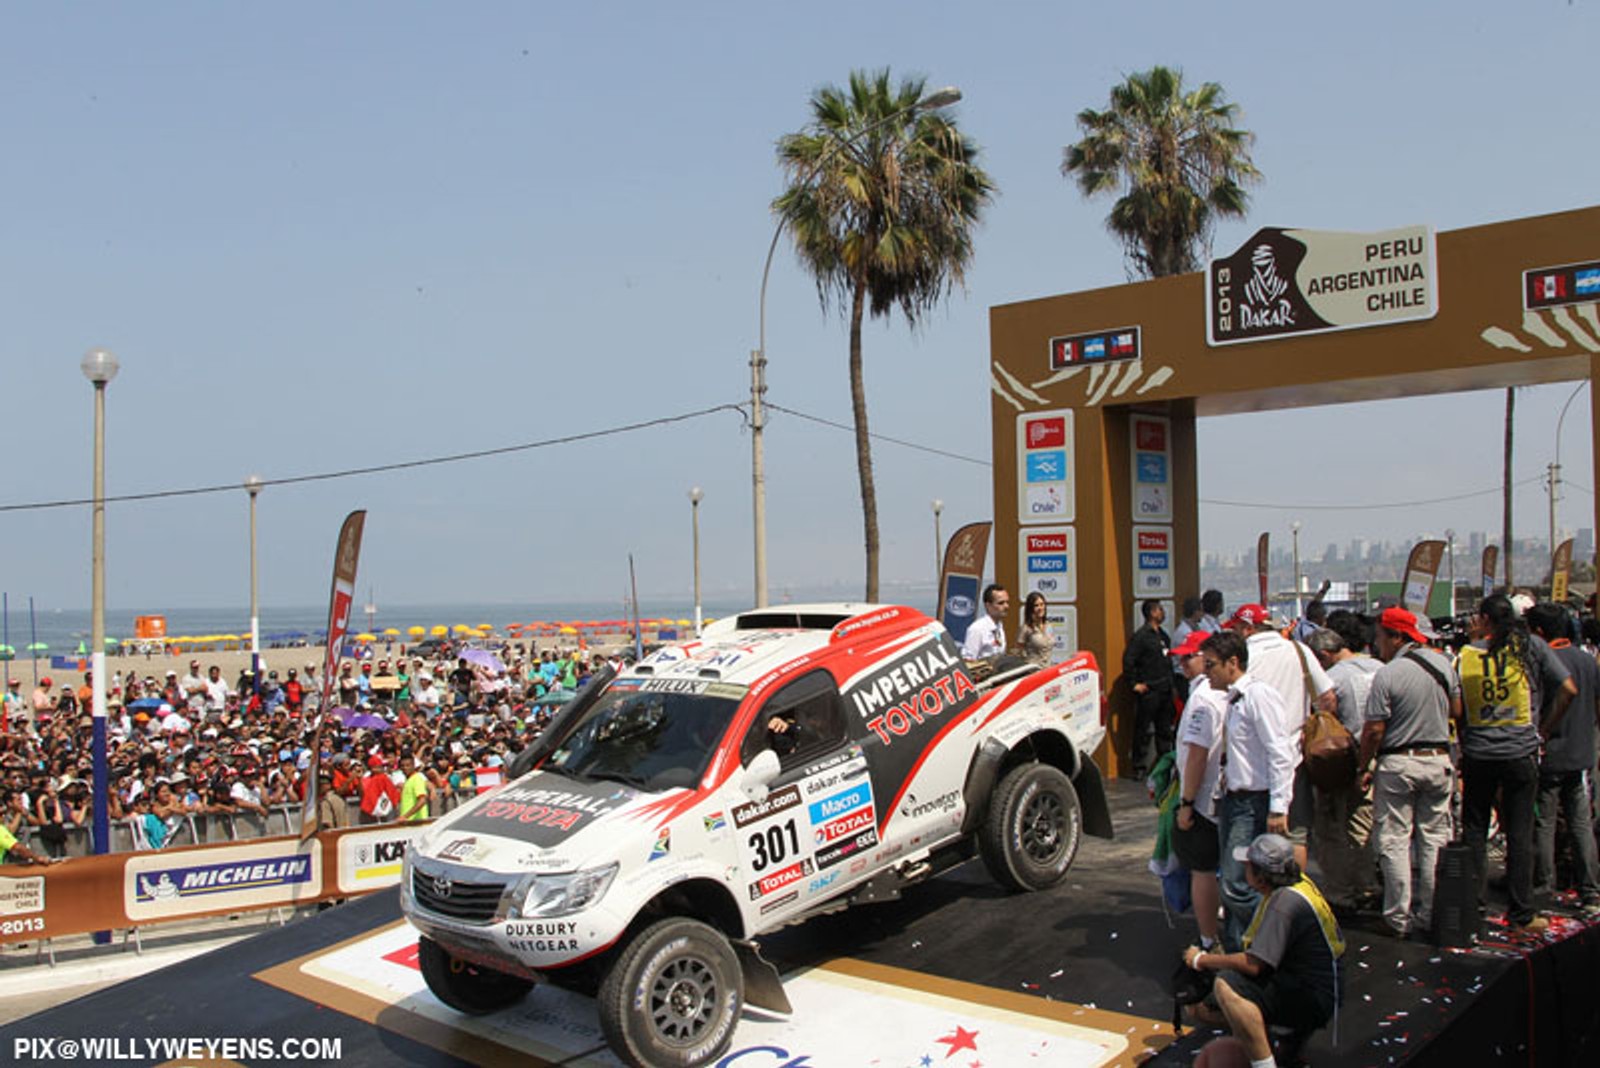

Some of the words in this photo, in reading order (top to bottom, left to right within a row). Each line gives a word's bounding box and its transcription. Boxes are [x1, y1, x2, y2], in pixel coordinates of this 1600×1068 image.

[1366, 236, 1423, 262] PERU
[1308, 263, 1425, 296] ARGENTINA
[1218, 268, 1232, 331] 2013
[1366, 288, 1425, 312] CHILE
[1239, 300, 1295, 330] DAKAR
[1030, 537, 1065, 548] TOTAL
[1032, 558, 1064, 569] Macro
[1141, 556, 1165, 567] Macro
[1478, 653, 1507, 678] TV
[645, 679, 700, 693] HILUX
[852, 644, 959, 718] IMPERIAL
[1482, 678, 1510, 702] 85
[867, 668, 975, 746] TOYOTA
[497, 787, 599, 813] IMPERIAL
[735, 790, 798, 823] dakar.com
[821, 793, 861, 818] Macro
[473, 801, 583, 831] TOYOTA
[827, 813, 873, 838] TOTAL
[749, 818, 800, 872] 301
[16, 881, 40, 890] PERU
[182, 859, 306, 888] MICHELIN
[762, 868, 801, 891] TOTAL
[809, 870, 842, 893] SKF
[0, 890, 39, 900] GENTINA
[15, 899, 38, 909] CHILE
[506, 922, 577, 936] DUXBURY
[509, 939, 580, 951] NETGEAR
